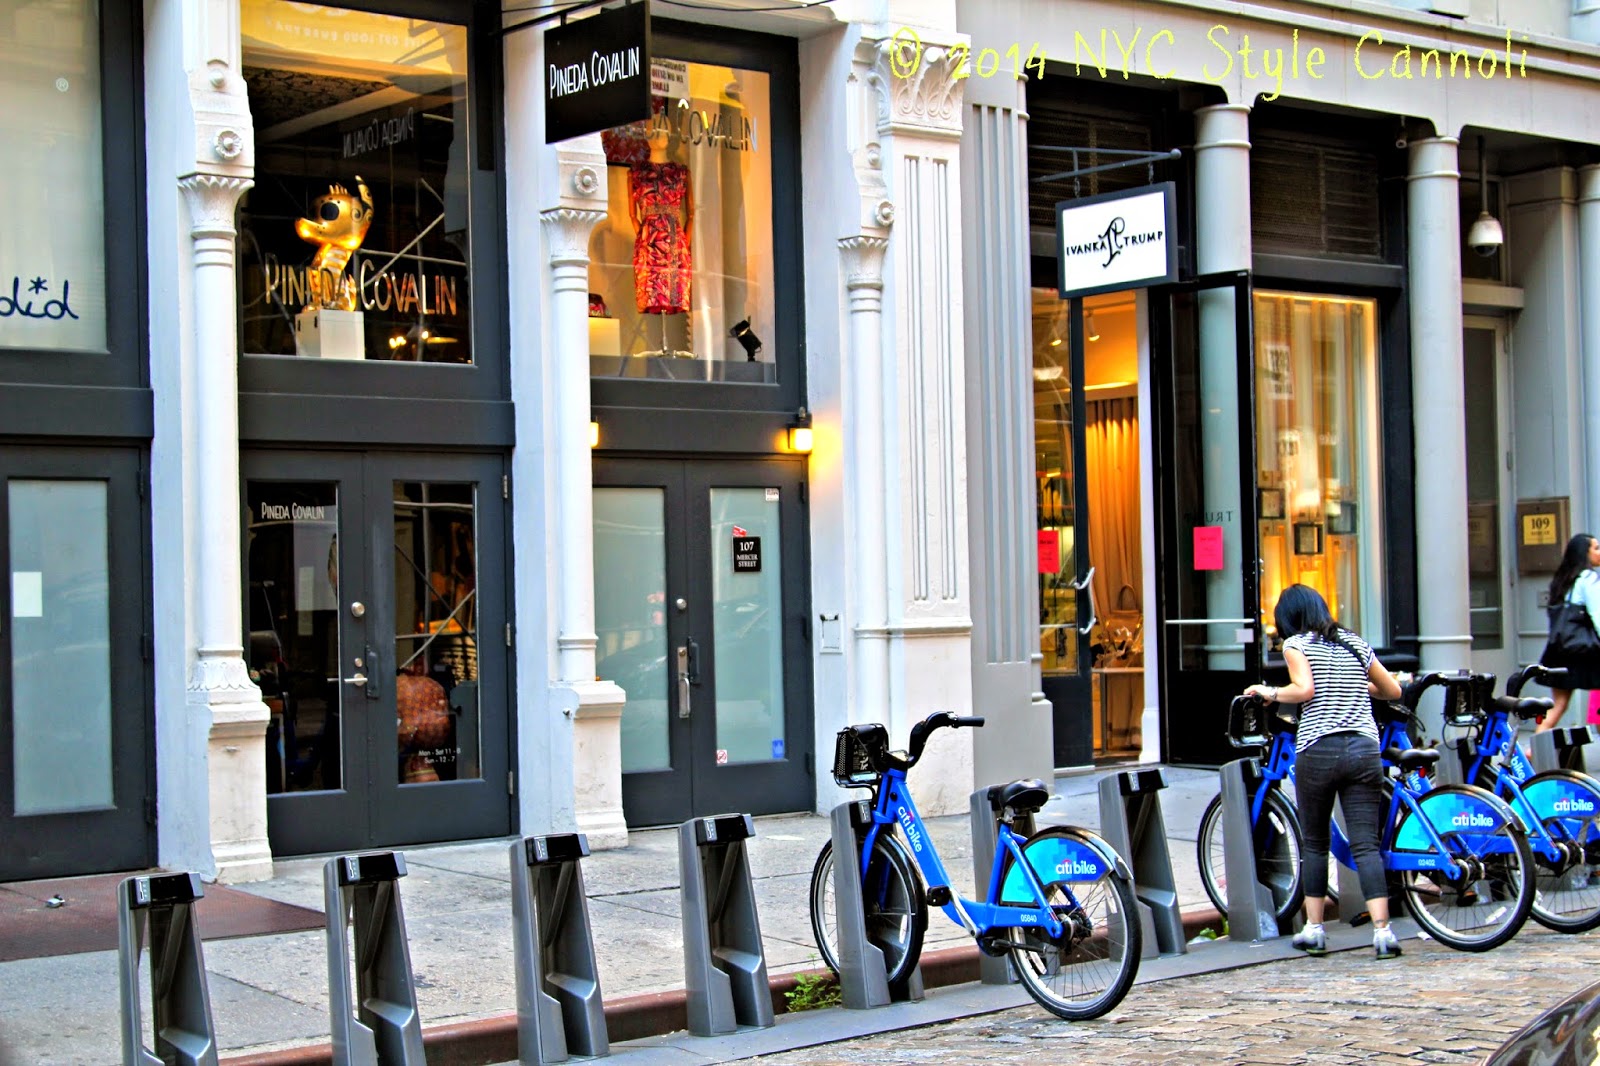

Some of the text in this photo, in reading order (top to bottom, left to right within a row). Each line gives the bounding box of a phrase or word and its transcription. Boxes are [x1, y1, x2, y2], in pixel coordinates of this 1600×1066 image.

[550, 46, 640, 99] PINEDA COVALIN
[1066, 240, 1107, 256] IVANKA
[1123, 231, 1163, 247] TRUMP
[265, 253, 457, 315] PINEDA COVALIN
[261, 502, 325, 519] PINEDA COVALIN
[1531, 517, 1550, 530] 109
[740, 541, 754, 551] 107
[1553, 798, 1594, 811] citi bike
[1452, 812, 1494, 827] citi bike
[898, 806, 922, 853] citi bike
[1056, 859, 1097, 874] citi bike
[1020, 914, 1037, 923] 05840
